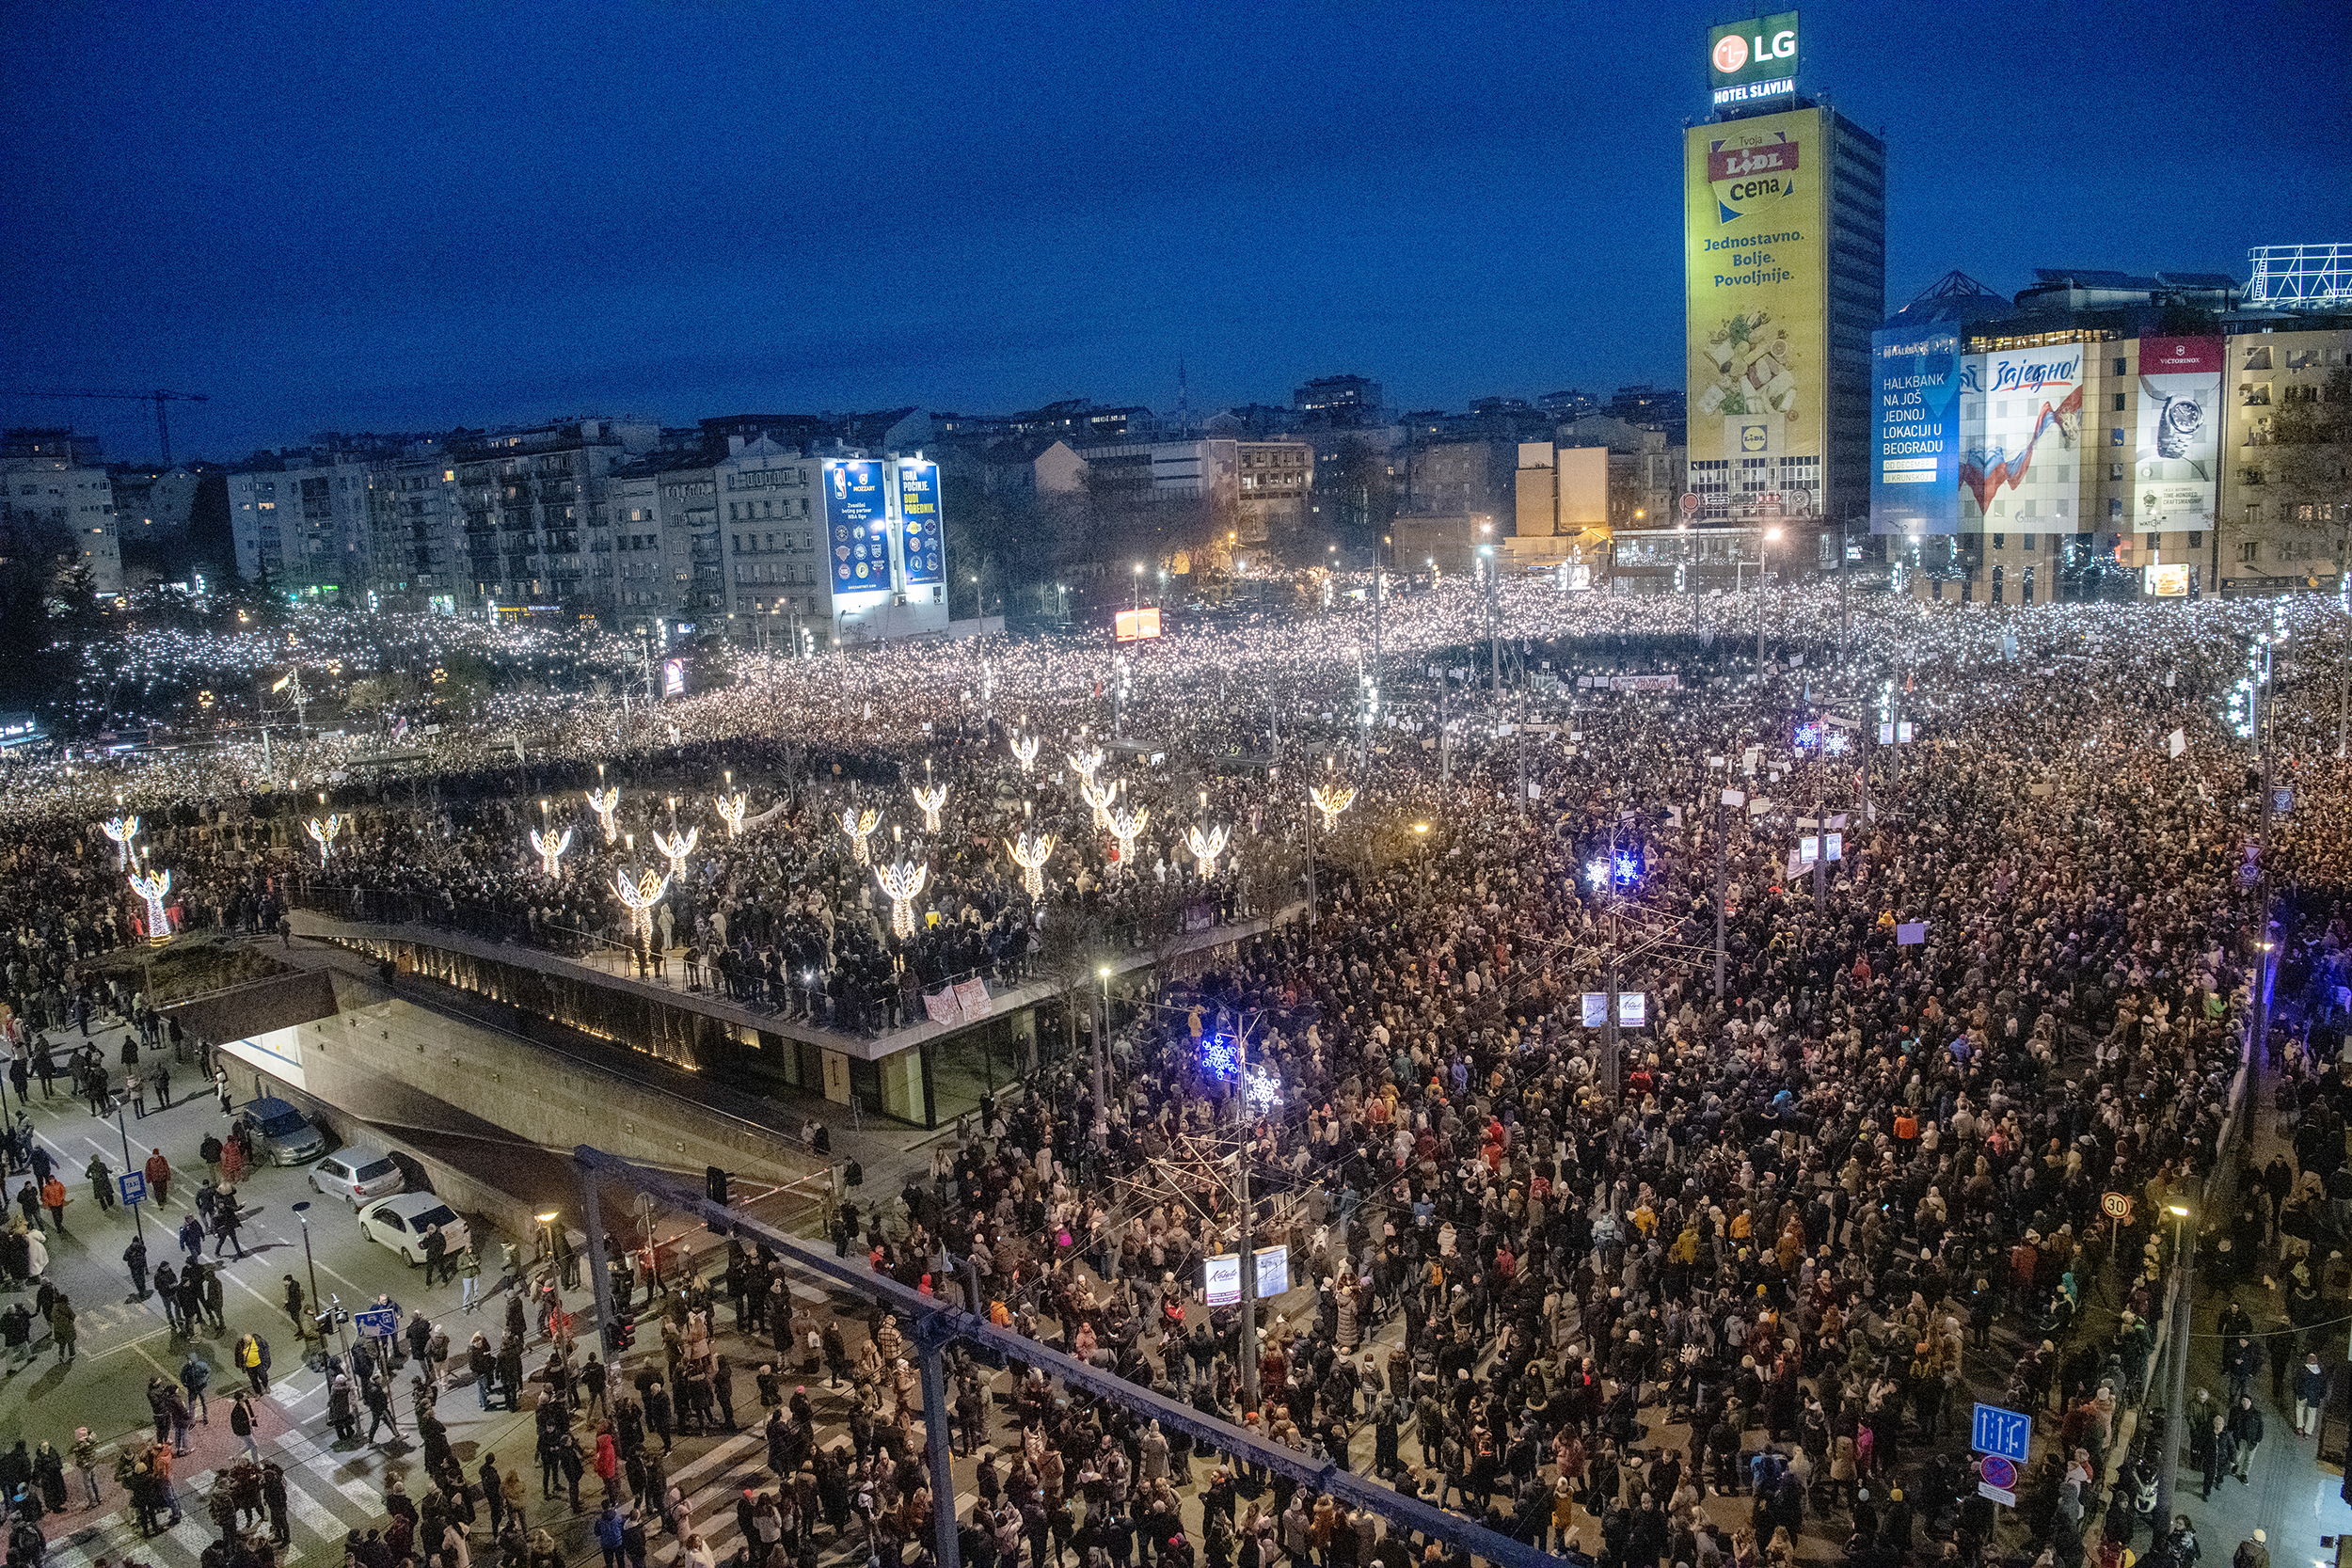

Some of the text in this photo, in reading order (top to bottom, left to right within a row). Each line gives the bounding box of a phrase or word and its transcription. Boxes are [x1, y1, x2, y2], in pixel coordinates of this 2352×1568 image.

[1754, 30, 1795, 63] LG
[1714, 78, 1794, 104] HOTEL SLAVIJA
[1740, 135, 1762, 146] Tvoja
[1729, 178, 1780, 201] cena
[1704, 230, 1804, 252] Jednostavno.
[1733, 251, 1775, 268] Bolje.
[1714, 268, 1794, 288] Povoljnije.
[1883, 373, 1945, 390] HALKBANK
[1883, 389, 1922, 406] NA JOŠ
[1883, 408, 1926, 423] JEDNOJ
[1883, 423, 1942, 439] LOKACIJI U
[1883, 440, 1943, 455] BEOGRADU
[1896, 460, 1934, 468] DECEMBRA
[903, 470, 917, 481] IGRA
[1891, 473, 1929, 482] KRUNSKOJ
[904, 493, 918, 503] BUDI
[905, 503, 935, 515] POBEDNIK.
[2107, 1198, 2123, 1212] 30
